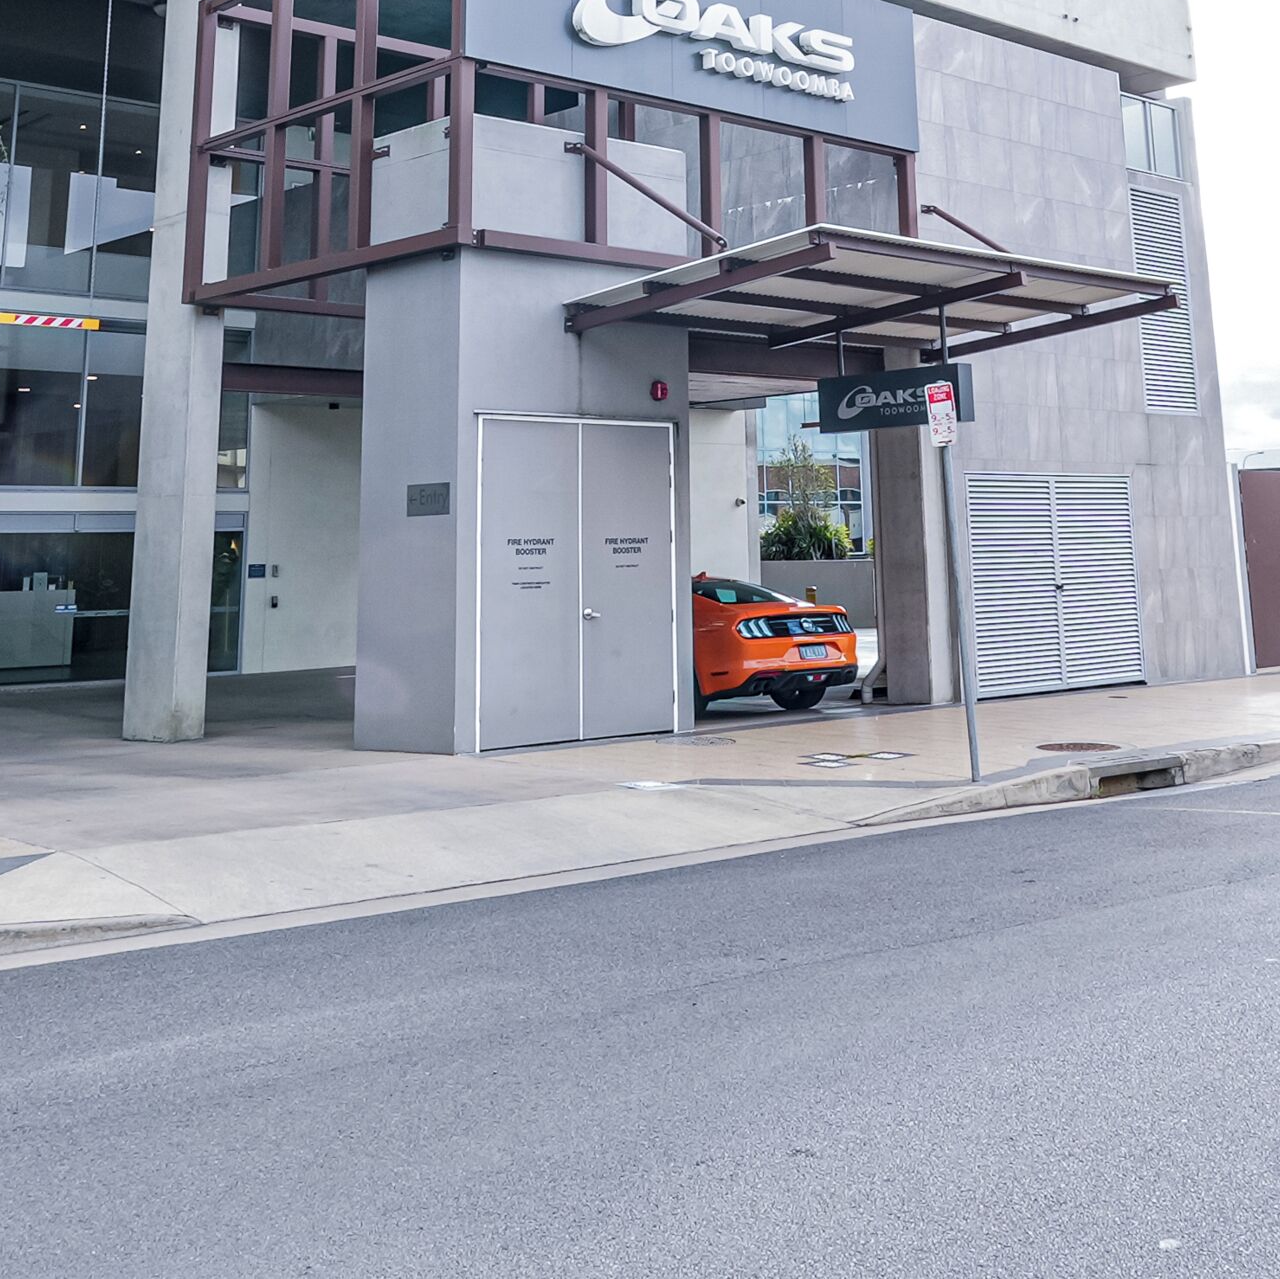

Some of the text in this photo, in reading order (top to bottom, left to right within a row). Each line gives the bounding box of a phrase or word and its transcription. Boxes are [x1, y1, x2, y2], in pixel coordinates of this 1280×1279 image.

[699, 48, 855, 103] TOOWOOMBA
[420, 488, 448, 508] Entry
[507, 538, 555, 546] FIRE HYDRANT
[605, 537, 649, 545] FIRE HYDRANT
[515, 547, 547, 556] BOOSTER
[612, 546, 642, 555] BOOSTER
